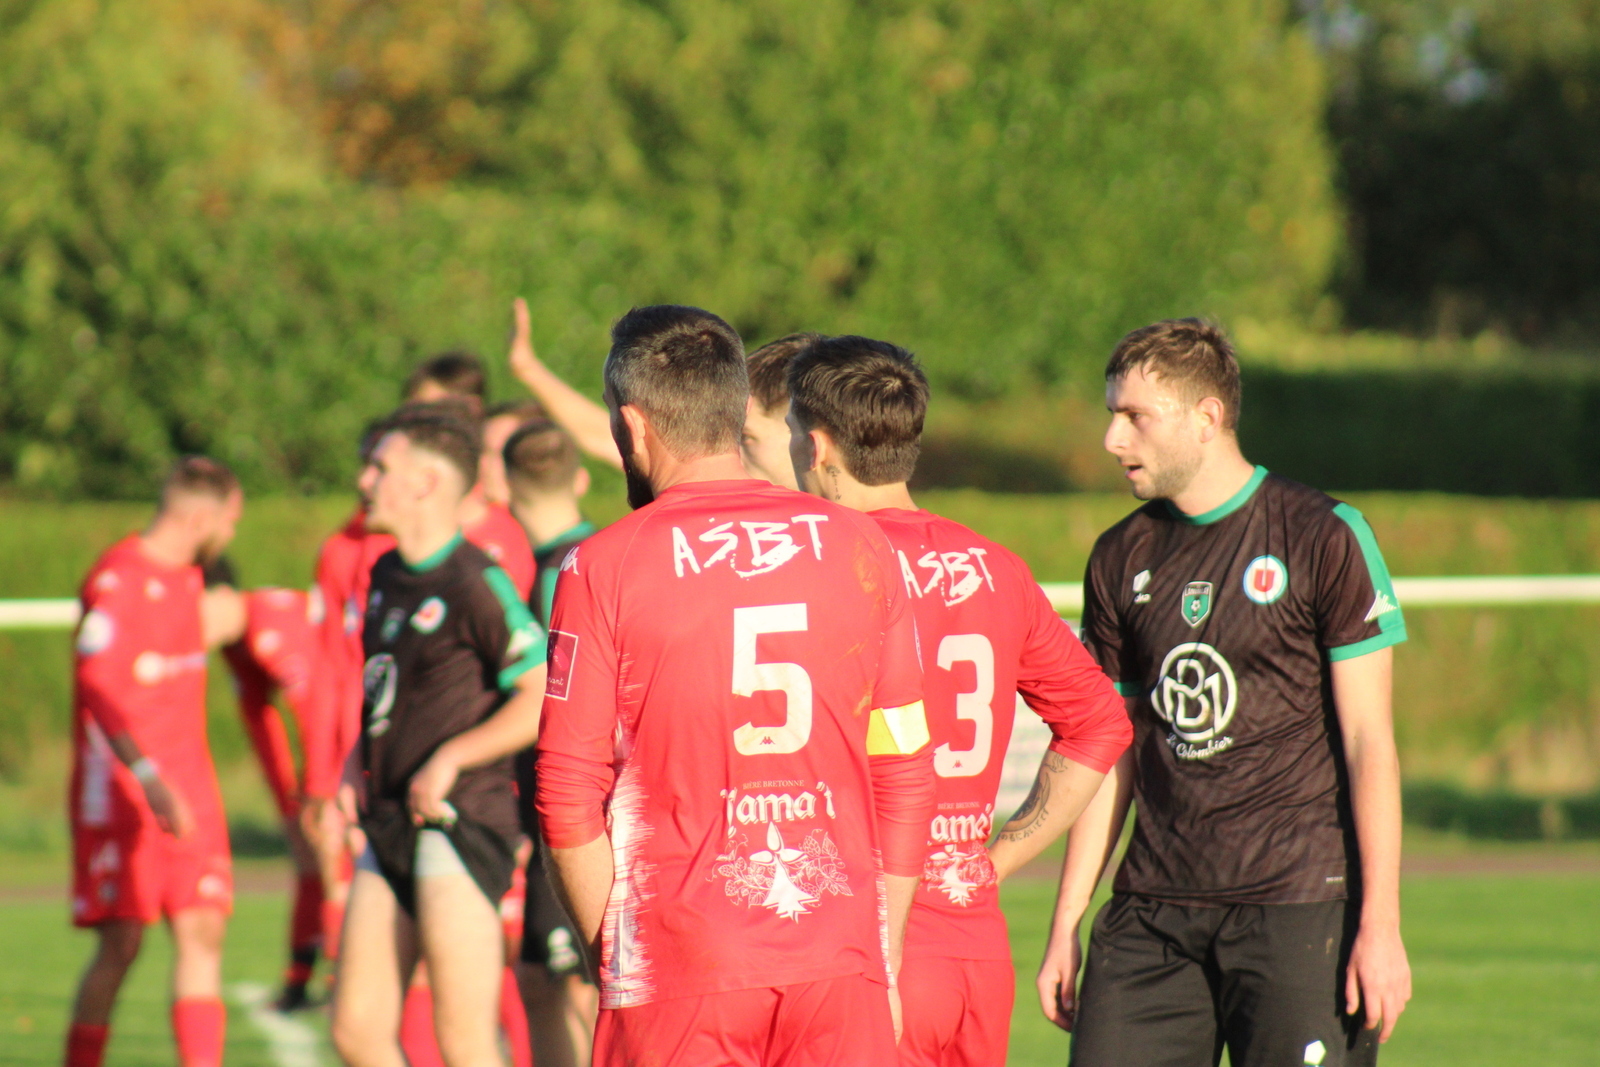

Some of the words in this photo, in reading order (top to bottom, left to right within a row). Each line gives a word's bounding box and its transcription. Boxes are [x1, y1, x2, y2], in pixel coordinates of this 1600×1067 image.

[672, 514, 829, 580] ASBT
[897, 546, 995, 608] ASBT
[1253, 568, 1276, 593] U
[731, 603, 813, 756] 5
[933, 633, 995, 778] 3
[1175, 735, 1234, 760] Colombier
[762, 779, 805, 788] BRETONNE
